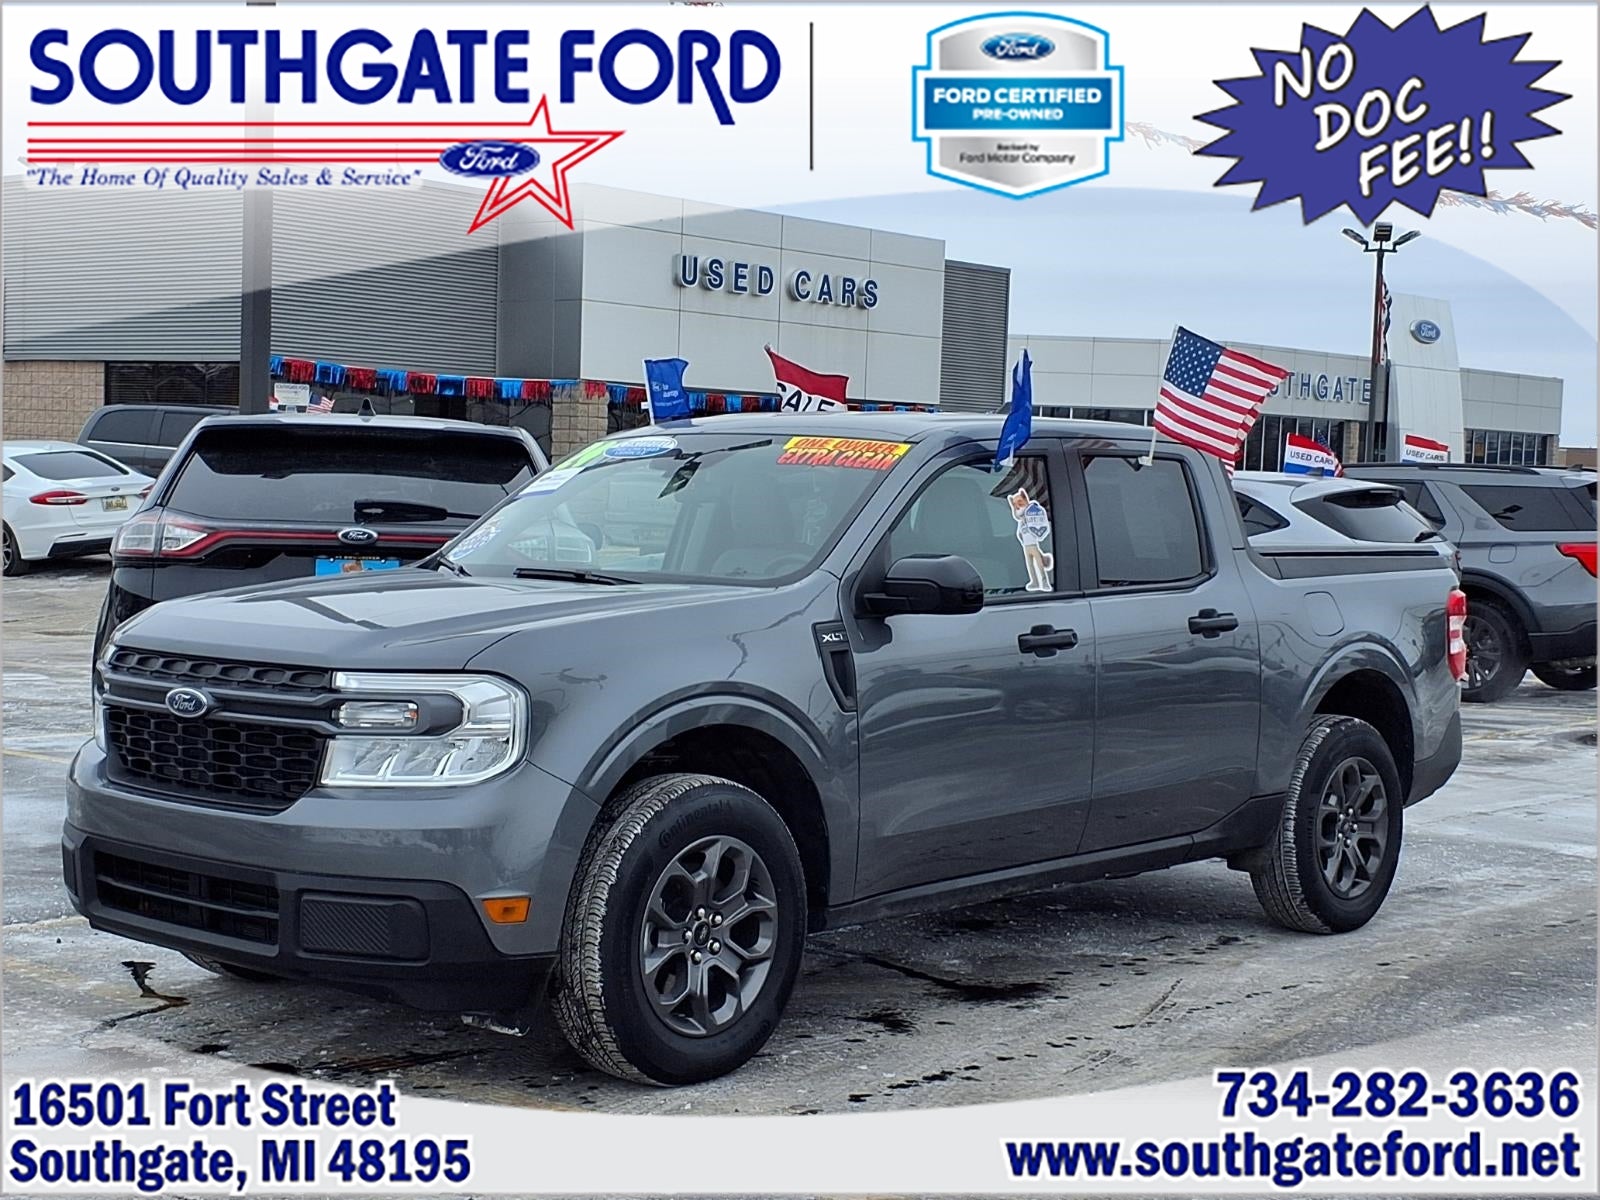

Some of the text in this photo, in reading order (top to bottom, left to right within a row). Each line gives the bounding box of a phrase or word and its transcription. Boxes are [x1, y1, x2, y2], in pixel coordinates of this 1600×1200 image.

[680, 254, 878, 310] USED CARS
[793, 438, 898, 455] ONE OWNER
[1406, 449, 1425, 458] USED
[777, 449, 900, 471] EXTRA CLEAN
[1290, 450, 1312, 461] USED
[346, 531, 369, 541] Ford
[822, 632, 843, 642] XLT
[173, 693, 196, 711] Ford
[659, 799, 722, 847] Continental
